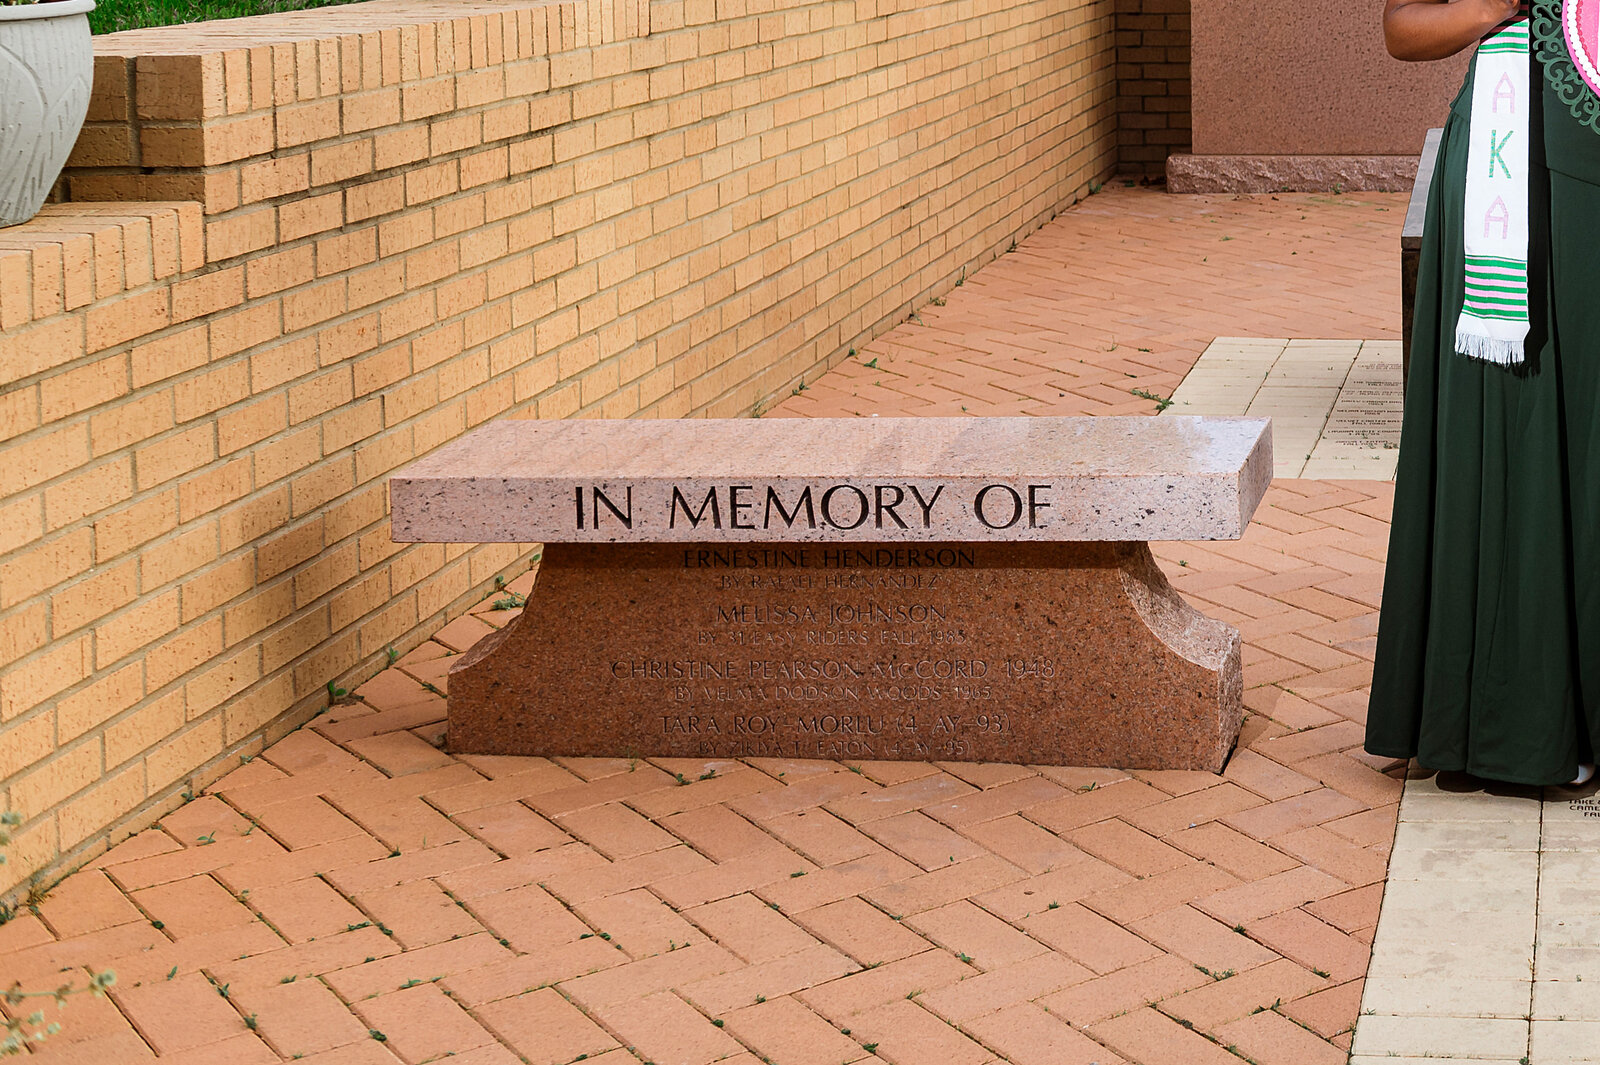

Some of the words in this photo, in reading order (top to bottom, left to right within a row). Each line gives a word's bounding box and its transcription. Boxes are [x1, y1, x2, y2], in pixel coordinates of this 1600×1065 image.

[575, 485, 634, 530] IN
[669, 485, 944, 531] MEMORY
[973, 485, 1053, 531] OF
[683, 548, 811, 569] ERNESTINE
[823, 548, 976, 569] HENDERSON
[720, 575, 743, 590] BY
[824, 574, 939, 590] HERNANDEZ
[716, 604, 819, 624] MELISSA
[829, 603, 947, 625] JOHNSON
[698, 631, 718, 645] BY
[730, 631, 745, 645] 31
[753, 631, 797, 646] EASY
[806, 631, 870, 645] RIDERS
[880, 630, 920, 645] FALL
[611, 660, 738, 680] CHRISTINE
[1004, 659, 1056, 678] 1948
[675, 687, 694, 701] BY
[704, 687, 768, 701] VELMA
[776, 687, 859, 701] DODSON
[660, 716, 721, 735] TARA
[699, 741, 720, 755] BY
[817, 741, 875, 756] EATON
